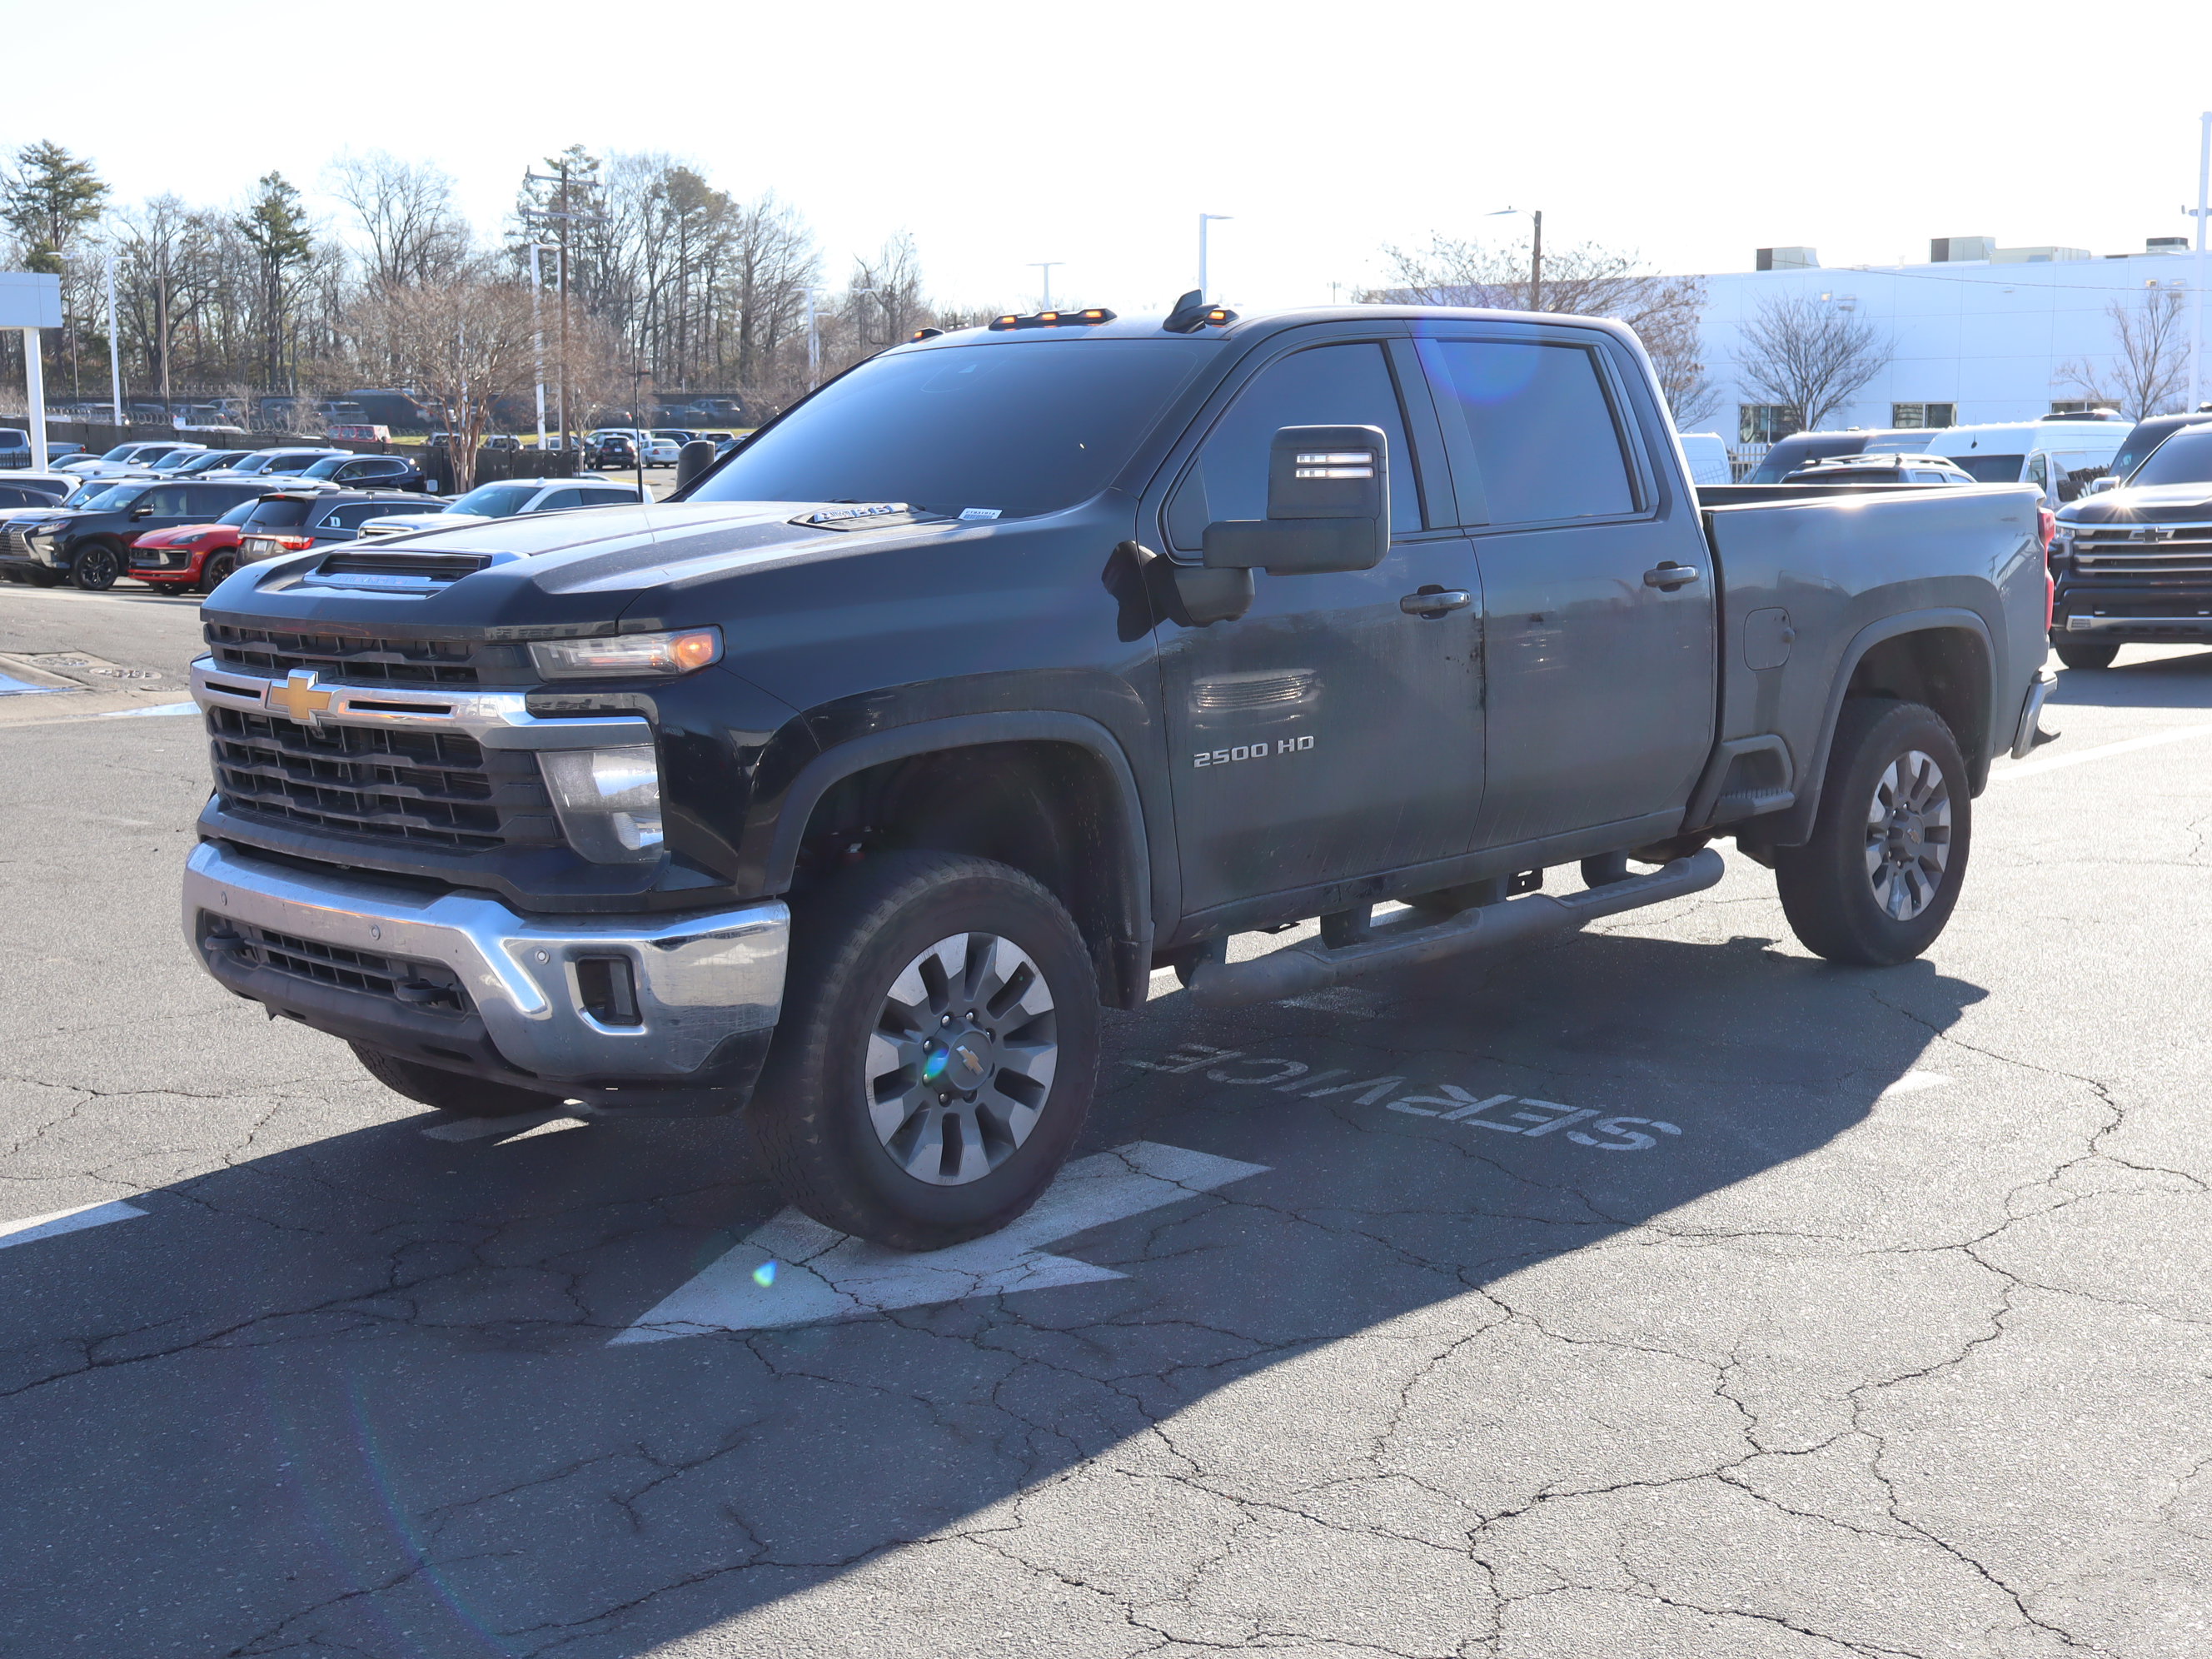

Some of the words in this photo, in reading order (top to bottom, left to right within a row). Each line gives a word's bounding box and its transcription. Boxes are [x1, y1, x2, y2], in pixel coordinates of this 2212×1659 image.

[1193, 742, 1268, 768] 2500
[1278, 735, 1314, 754] HD
[1118, 1042, 1682, 1151] SERVICE
